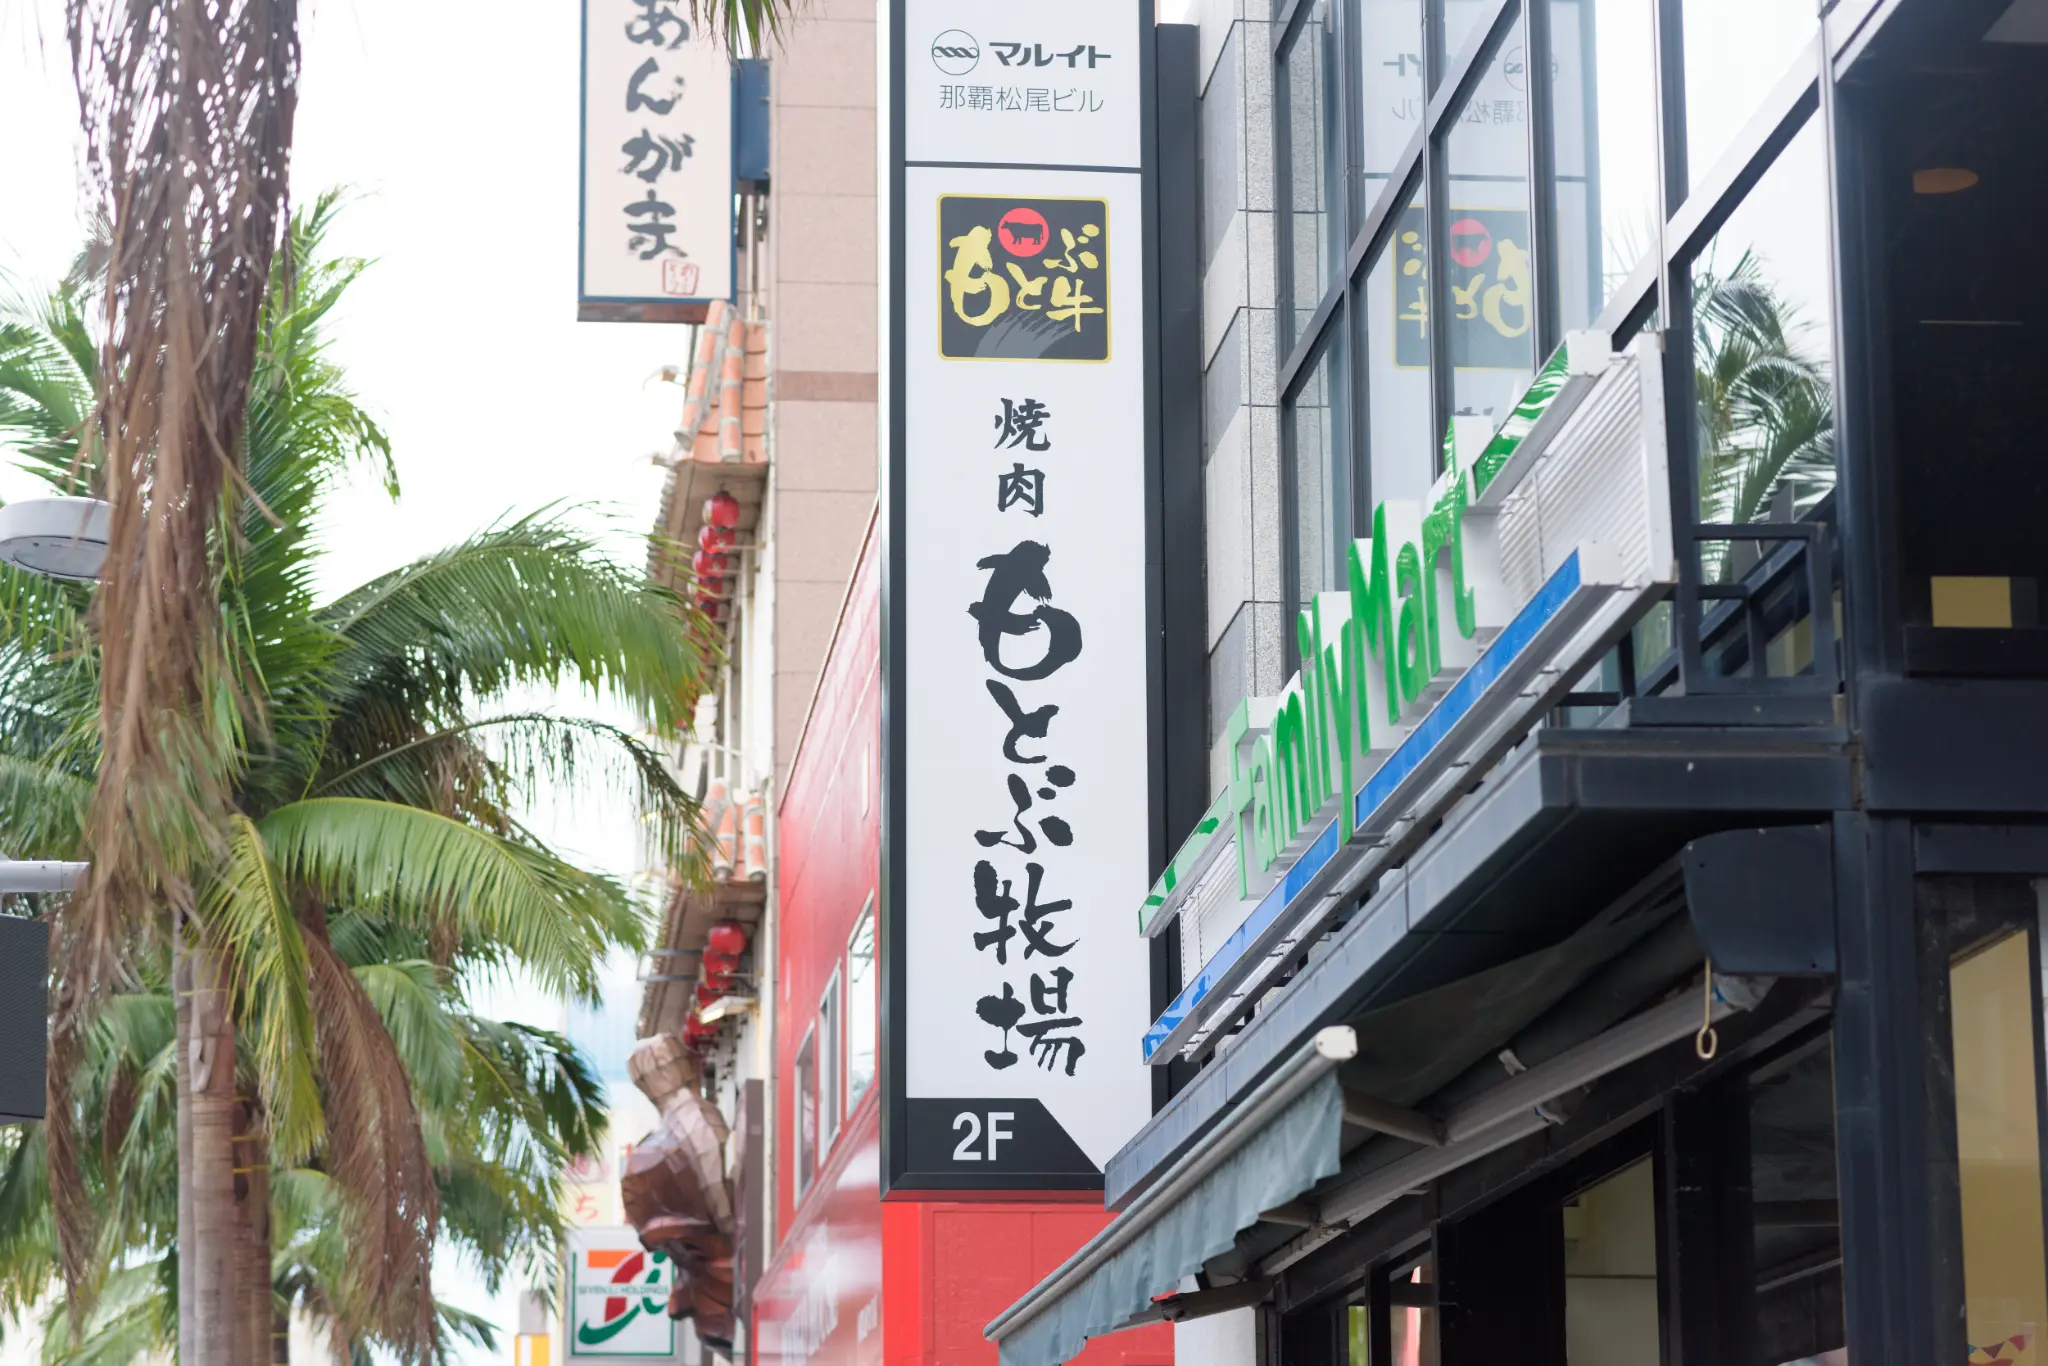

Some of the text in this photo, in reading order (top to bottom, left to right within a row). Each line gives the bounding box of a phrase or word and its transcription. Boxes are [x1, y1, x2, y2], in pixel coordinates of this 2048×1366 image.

[940, 84, 1104, 113] 那覇松尾ビル
[989, 42, 1112, 69] マルイト
[617, 0, 696, 261] あんがま
[994, 397, 1051, 518] 焼肉
[1228, 415, 1475, 901] FamilyMart
[966, 540, 1085, 1077] もとぶ牧場
[952, 1111, 1015, 1161] 2F
